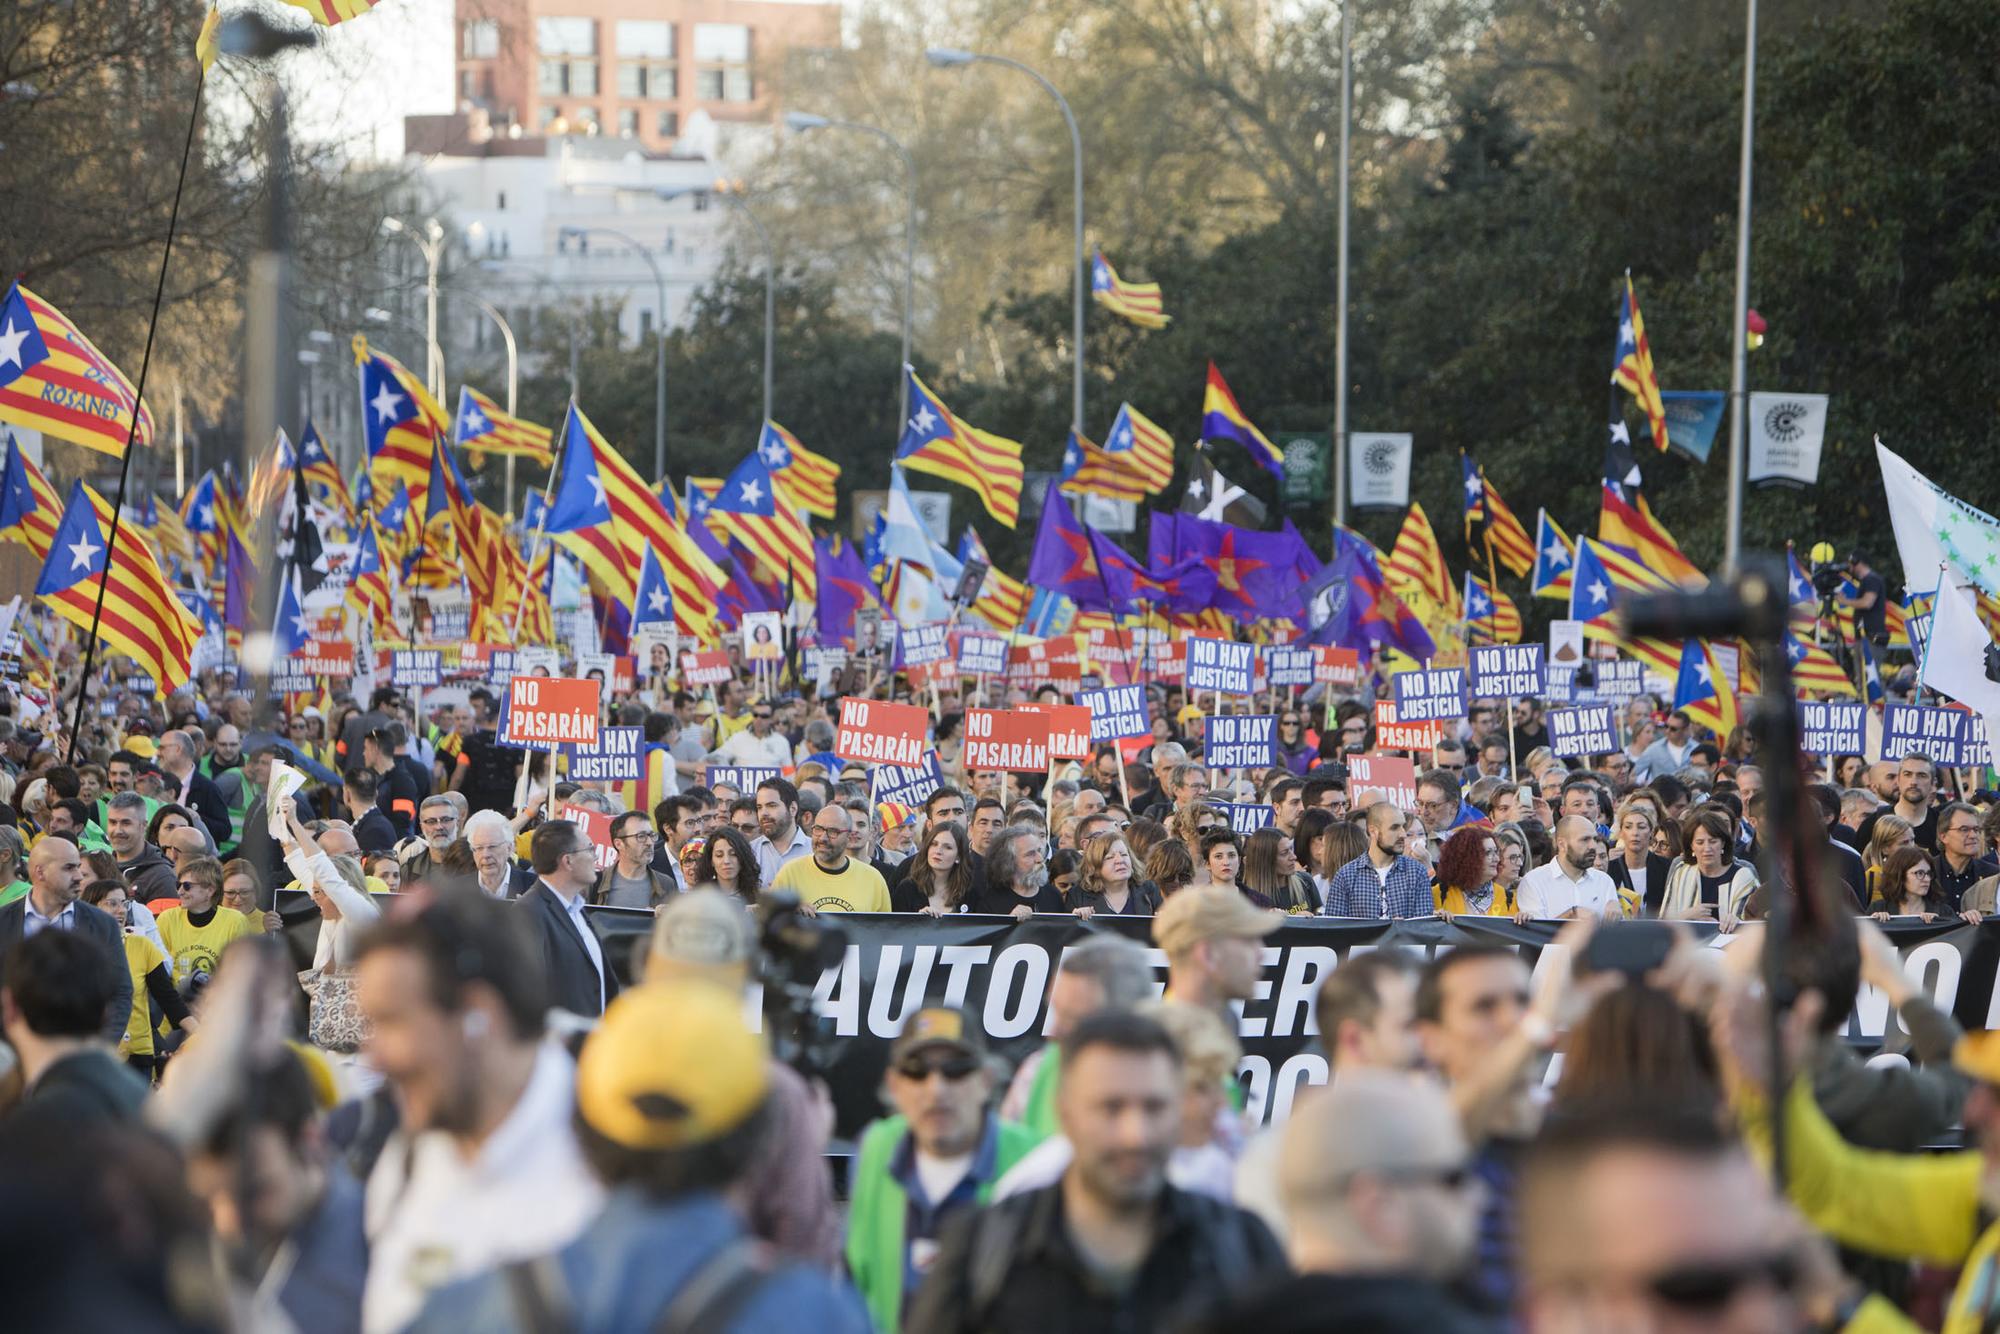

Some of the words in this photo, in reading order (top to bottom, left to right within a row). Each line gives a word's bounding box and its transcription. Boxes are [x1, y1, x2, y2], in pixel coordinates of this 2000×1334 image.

[305, 642, 320, 656] NO
[396, 652, 412, 669] NO
[415, 652, 437, 669] HAY
[462, 642, 477, 658] NO
[494, 652, 511, 668] NO
[1194, 640, 1216, 665] NO
[1219, 642, 1250, 669] HAY
[1273, 653, 1289, 668] NO
[1291, 652, 1312, 668] HAY
[1478, 650, 1501, 673] NO
[1506, 648, 1538, 672] HAY
[1190, 666, 1248, 691] JUSTÍCIA
[1598, 663, 1615, 679] NO
[1617, 661, 1640, 678] HAY
[514, 680, 538, 706] NO
[1401, 673, 1424, 697] NO
[1429, 670, 1460, 695] HAY
[1475, 673, 1539, 696] JUSTÍCIA
[1082, 692, 1106, 716] NO
[1109, 687, 1140, 712] HAY
[1378, 704, 1396, 723] NO
[1400, 695, 1462, 720] JUSTÍCIA
[513, 707, 595, 739] PASARÁN
[843, 701, 869, 728] NO
[968, 713, 992, 737] NO
[1553, 712, 1576, 735] NO
[1578, 707, 1608, 731] HAY
[1804, 705, 1827, 730] NO
[1830, 706, 1862, 730] HAY
[1892, 708, 1919, 734] NO
[1922, 711, 1961, 738] HAY
[605, 730, 639, 754] HAY
[1049, 729, 1088, 756] ARÁN
[1213, 719, 1235, 743] NO
[1240, 718, 1272, 742] HAY
[1801, 730, 1859, 752] JUSTÍCIA
[839, 730, 922, 765] PASARÁN
[966, 738, 1046, 768] PASARÁN
[1208, 742, 1270, 765] JUSTÍCIA
[1554, 732, 1612, 756] JUSTÍCIA
[1885, 736, 1956, 763] JUSTÍCIA
[573, 754, 638, 778] JUSTÍCIA
[1350, 758, 1371, 781] NO
[877, 766, 900, 792] NO
[1233, 808, 1269, 832] HAY
